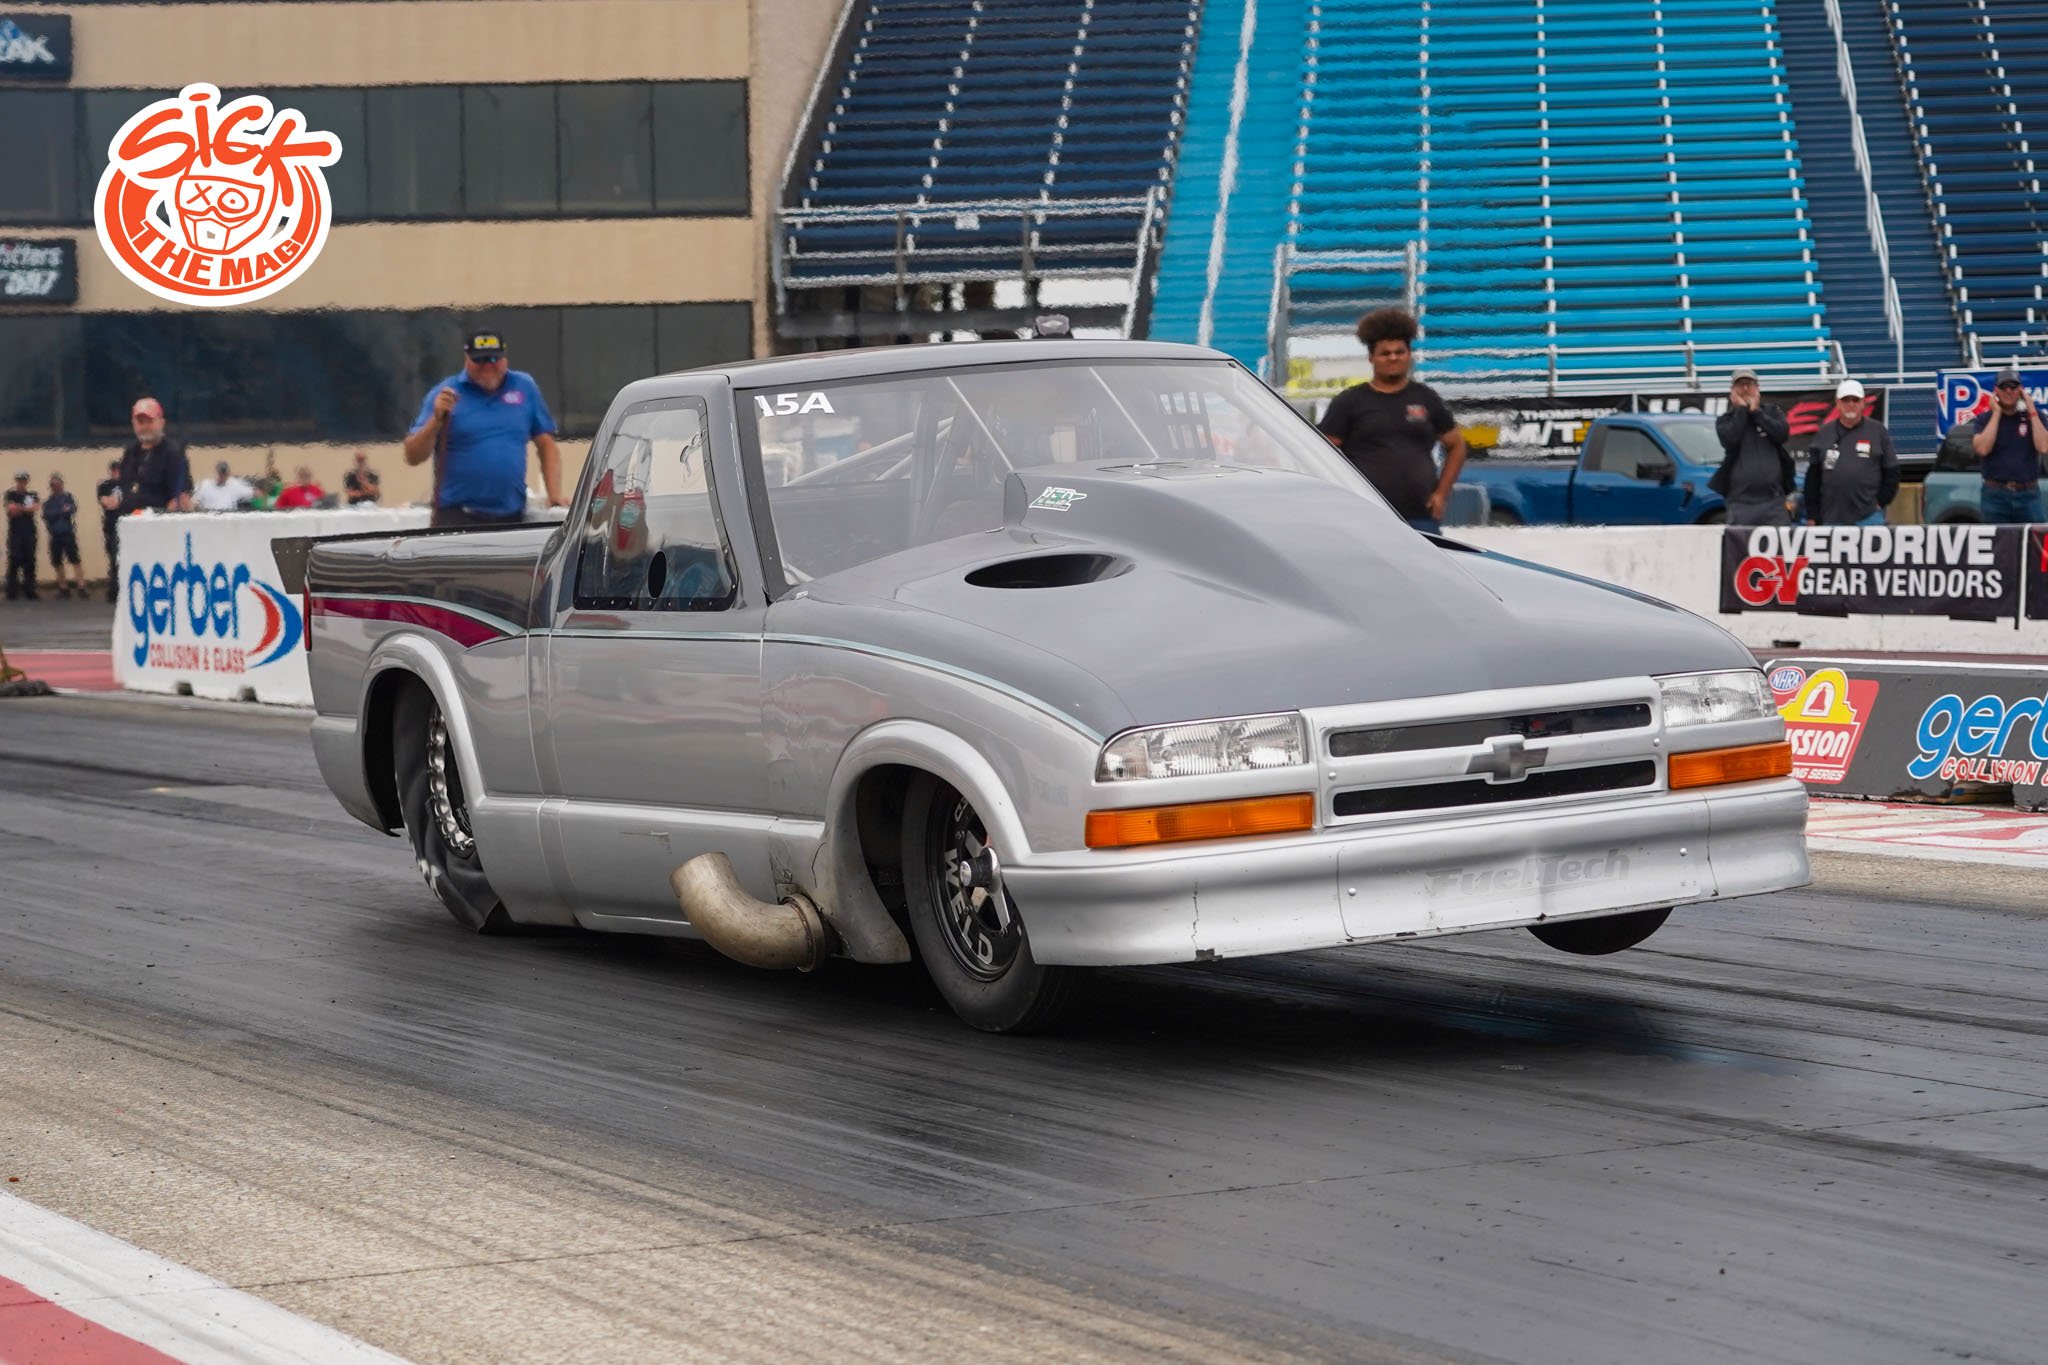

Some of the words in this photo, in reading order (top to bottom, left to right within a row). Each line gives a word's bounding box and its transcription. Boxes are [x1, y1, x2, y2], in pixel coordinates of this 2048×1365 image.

[1748, 525, 1998, 566] OVERDRIVE
[1801, 568, 1868, 596] GEAR
[1874, 569, 2003, 599] VENDORS
[129, 531, 251, 668] gerber
[150, 643, 200, 671] COLLISION
[213, 647, 246, 674] GLASS
[1772, 670, 1803, 689] NHRA
[1940, 756, 2042, 785] COLLISION
[1424, 849, 1631, 895] FuelTech
